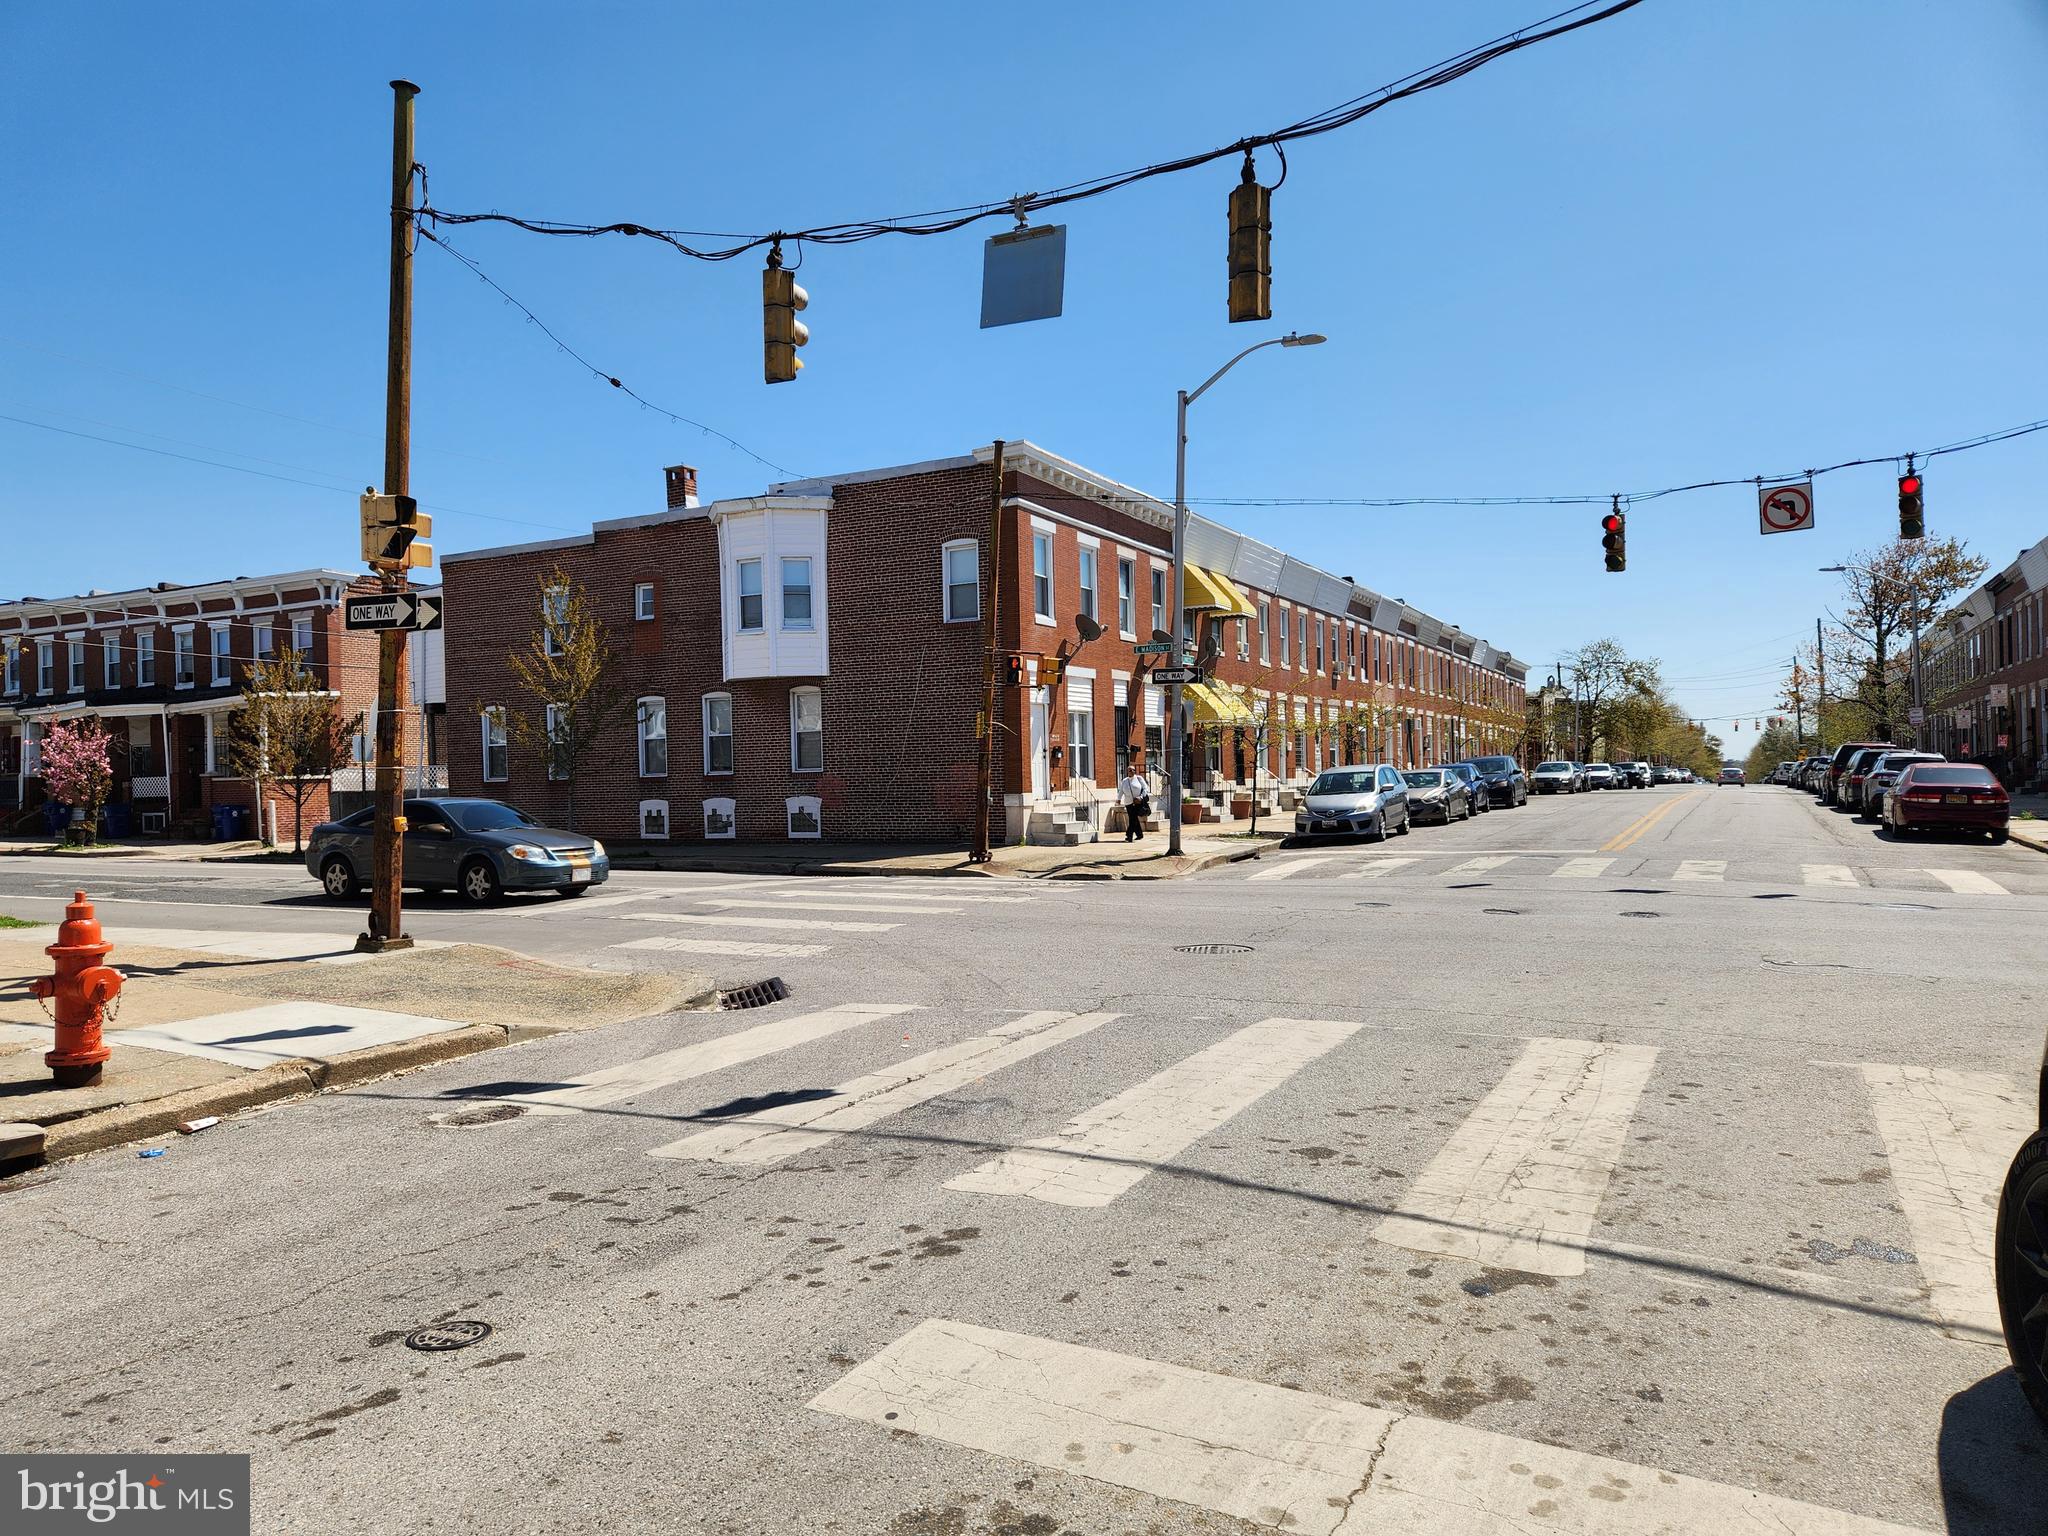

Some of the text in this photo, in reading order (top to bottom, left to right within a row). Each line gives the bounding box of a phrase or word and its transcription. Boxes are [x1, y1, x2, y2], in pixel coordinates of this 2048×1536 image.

[353, 605, 395, 620] ONE WAY
[1142, 645, 1164, 653] MADISON
